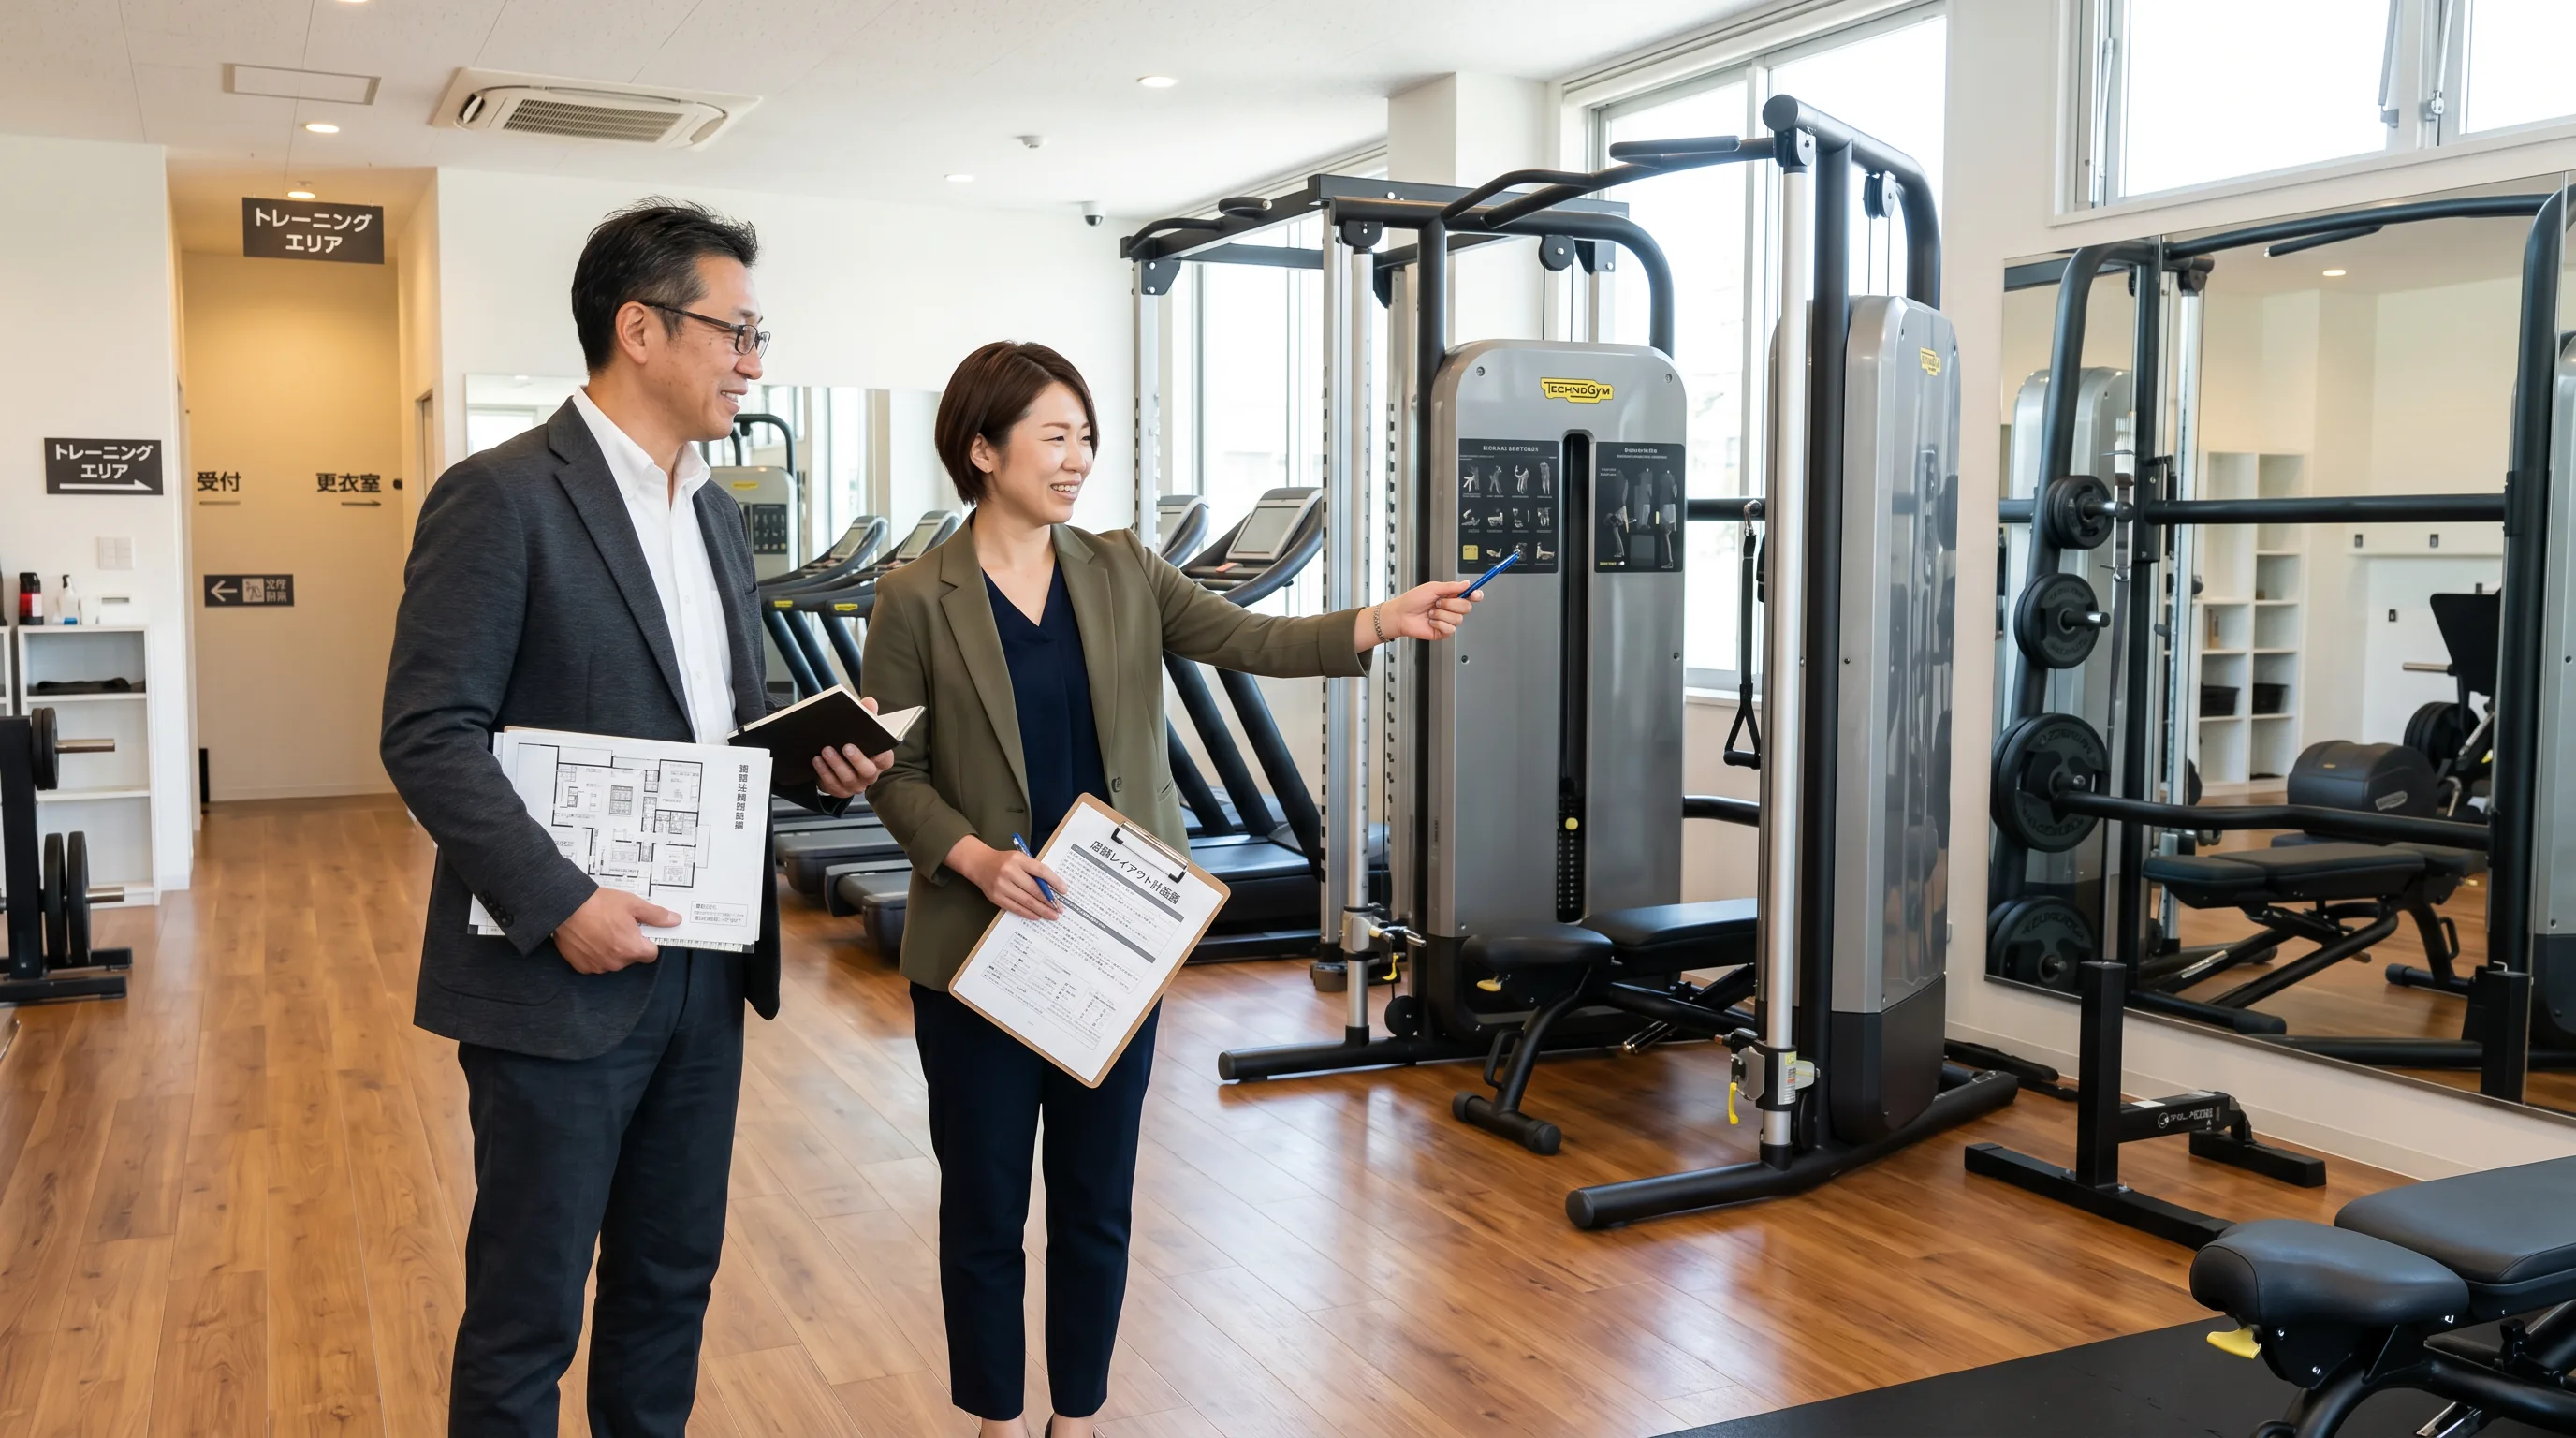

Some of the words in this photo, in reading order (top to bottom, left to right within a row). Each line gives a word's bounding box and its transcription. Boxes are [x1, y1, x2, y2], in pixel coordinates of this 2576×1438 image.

[256, 207, 373, 233] トレーニング
[285, 234, 343, 254] エリア
[55, 443, 154, 461] トレーニング
[80, 463, 128, 479] エリア
[197, 471, 242, 492] 受付
[315, 473, 382, 493] 更衣室
